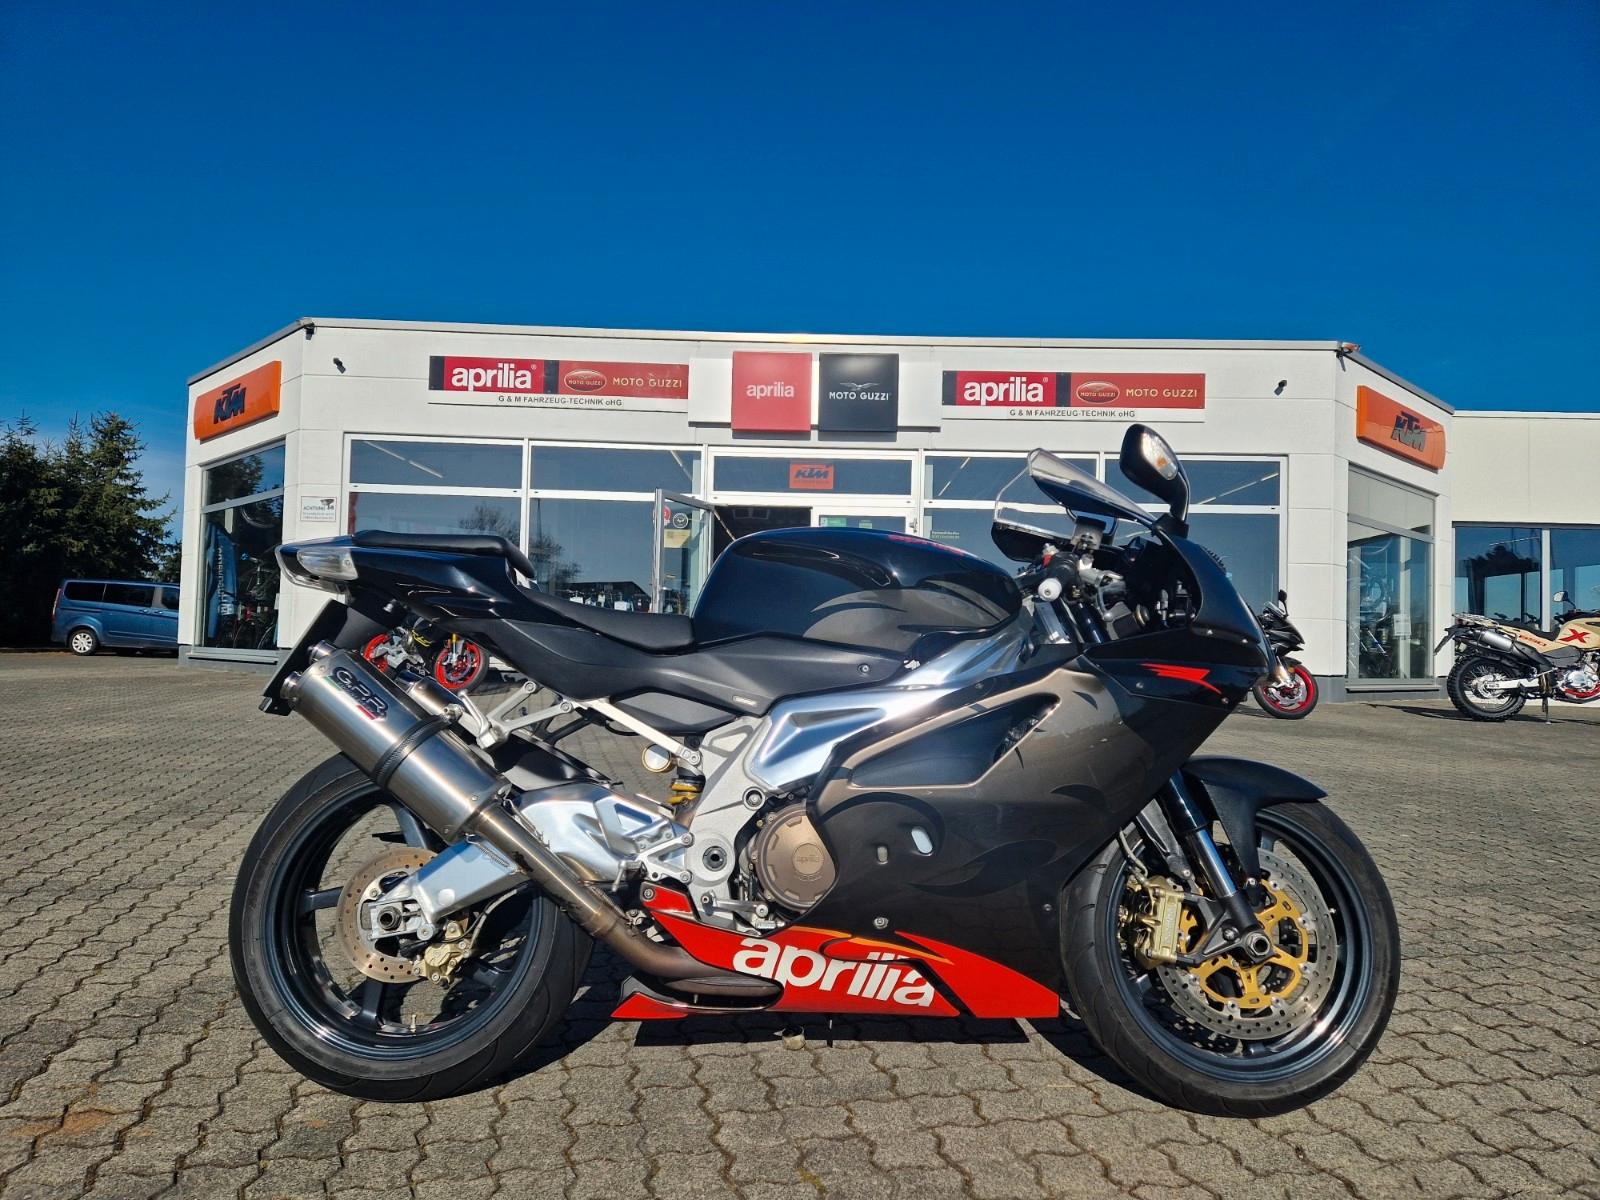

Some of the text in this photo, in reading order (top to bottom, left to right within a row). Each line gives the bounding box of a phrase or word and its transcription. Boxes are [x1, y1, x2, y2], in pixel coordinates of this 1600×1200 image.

[612, 377, 682, 388] MOTO GUZZI
[746, 382, 795, 399] aprilia
[829, 391, 889, 400] MOTO GUZZI
[1125, 388, 1198, 398] MOTO GUZZI
[213, 383, 247, 424] KTM
[523, 396, 604, 405] FAHRZEUG-TECHNIK
[1391, 410, 1426, 452] KTM
[795, 464, 831, 479] KTM
[733, 937, 935, 1007] aprilia
